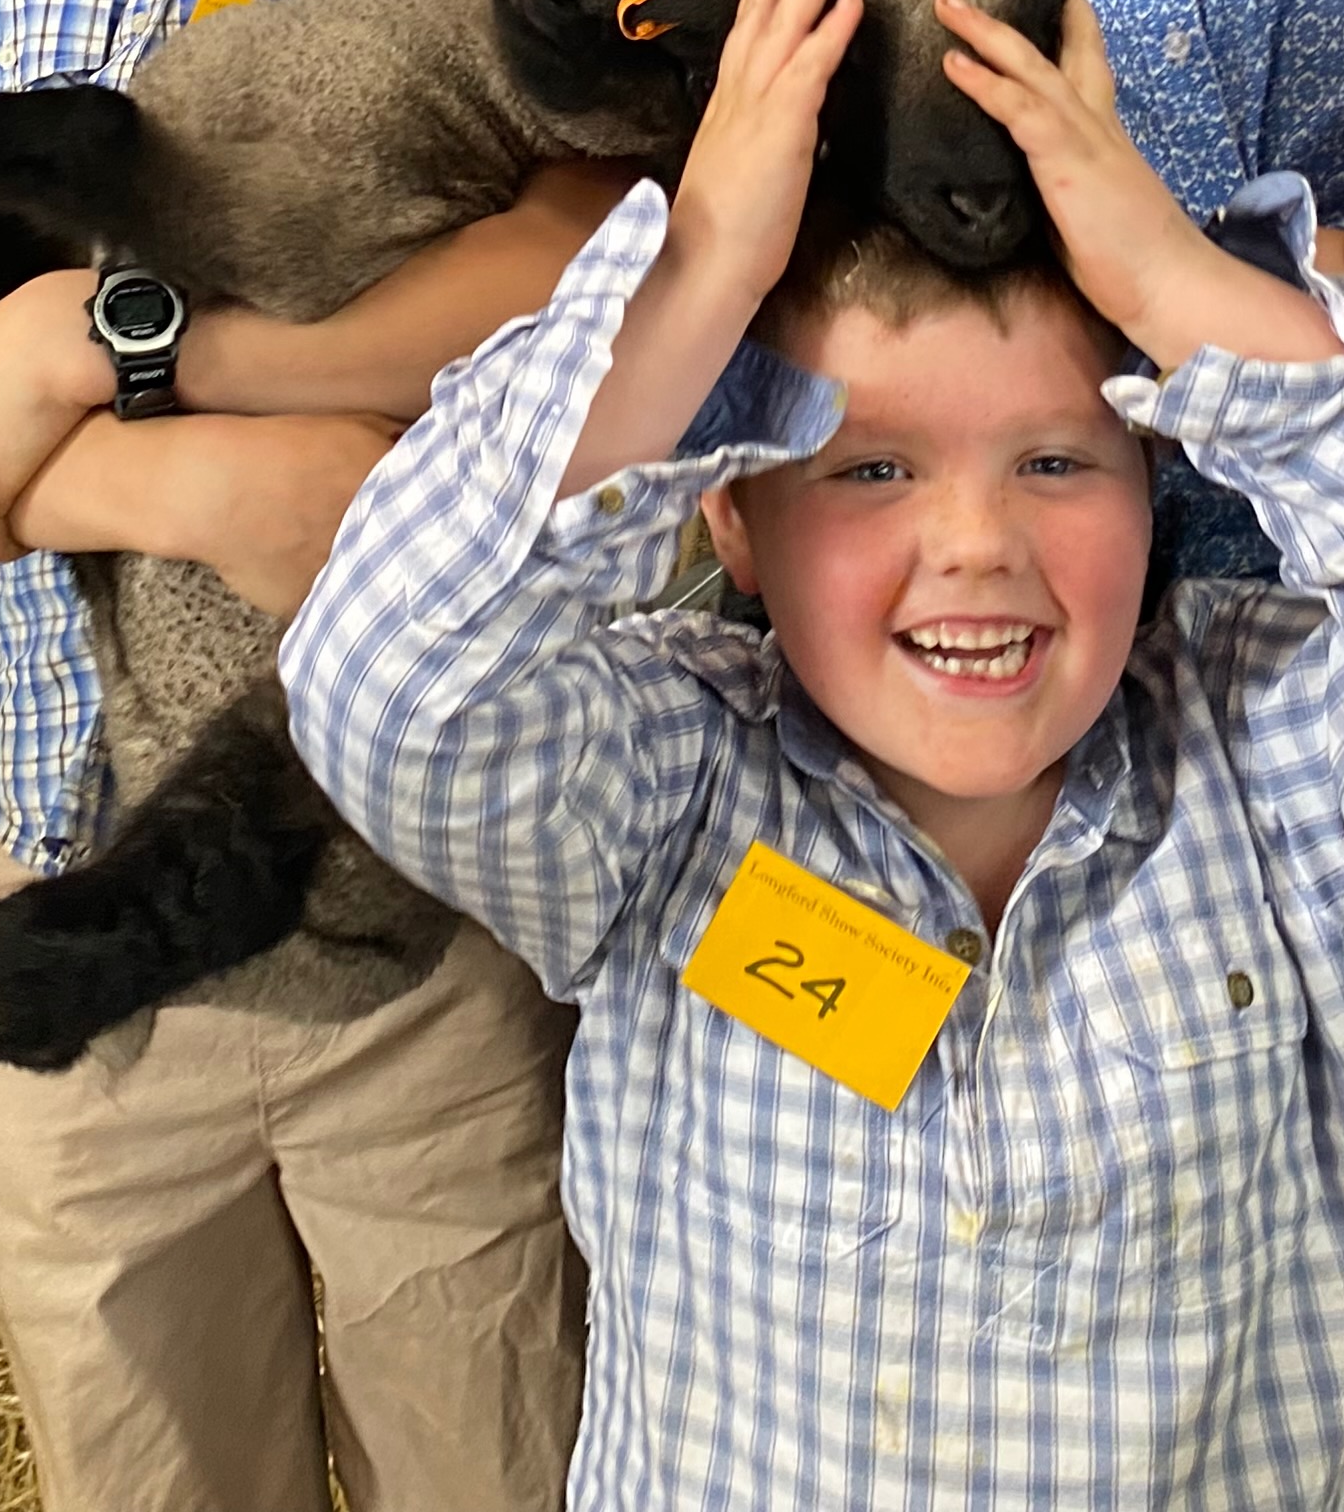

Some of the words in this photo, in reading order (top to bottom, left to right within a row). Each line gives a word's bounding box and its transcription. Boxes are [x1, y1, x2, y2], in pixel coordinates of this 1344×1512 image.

[748, 861, 818, 914] Longford
[819, 900, 863, 940] Show
[864, 932, 919, 976] Society
[744, 938, 847, 1020] 24
